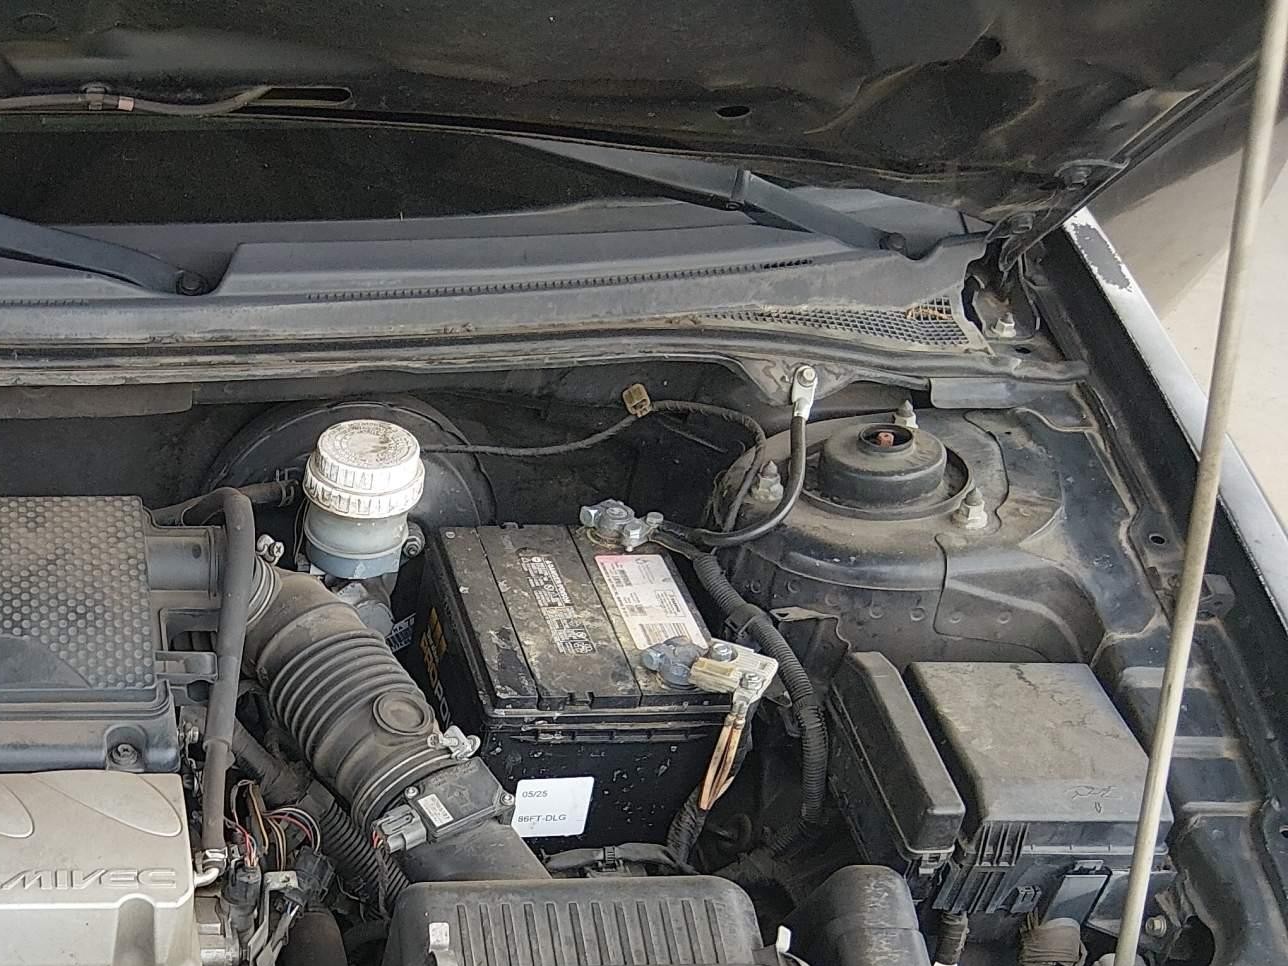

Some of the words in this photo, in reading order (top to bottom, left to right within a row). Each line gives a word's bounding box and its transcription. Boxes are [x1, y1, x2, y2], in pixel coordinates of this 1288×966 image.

[522, 790, 548, 799] 05/25
[517, 813, 567, 824] 86FT-DLG
[0, 868, 177, 890] MIVEC
